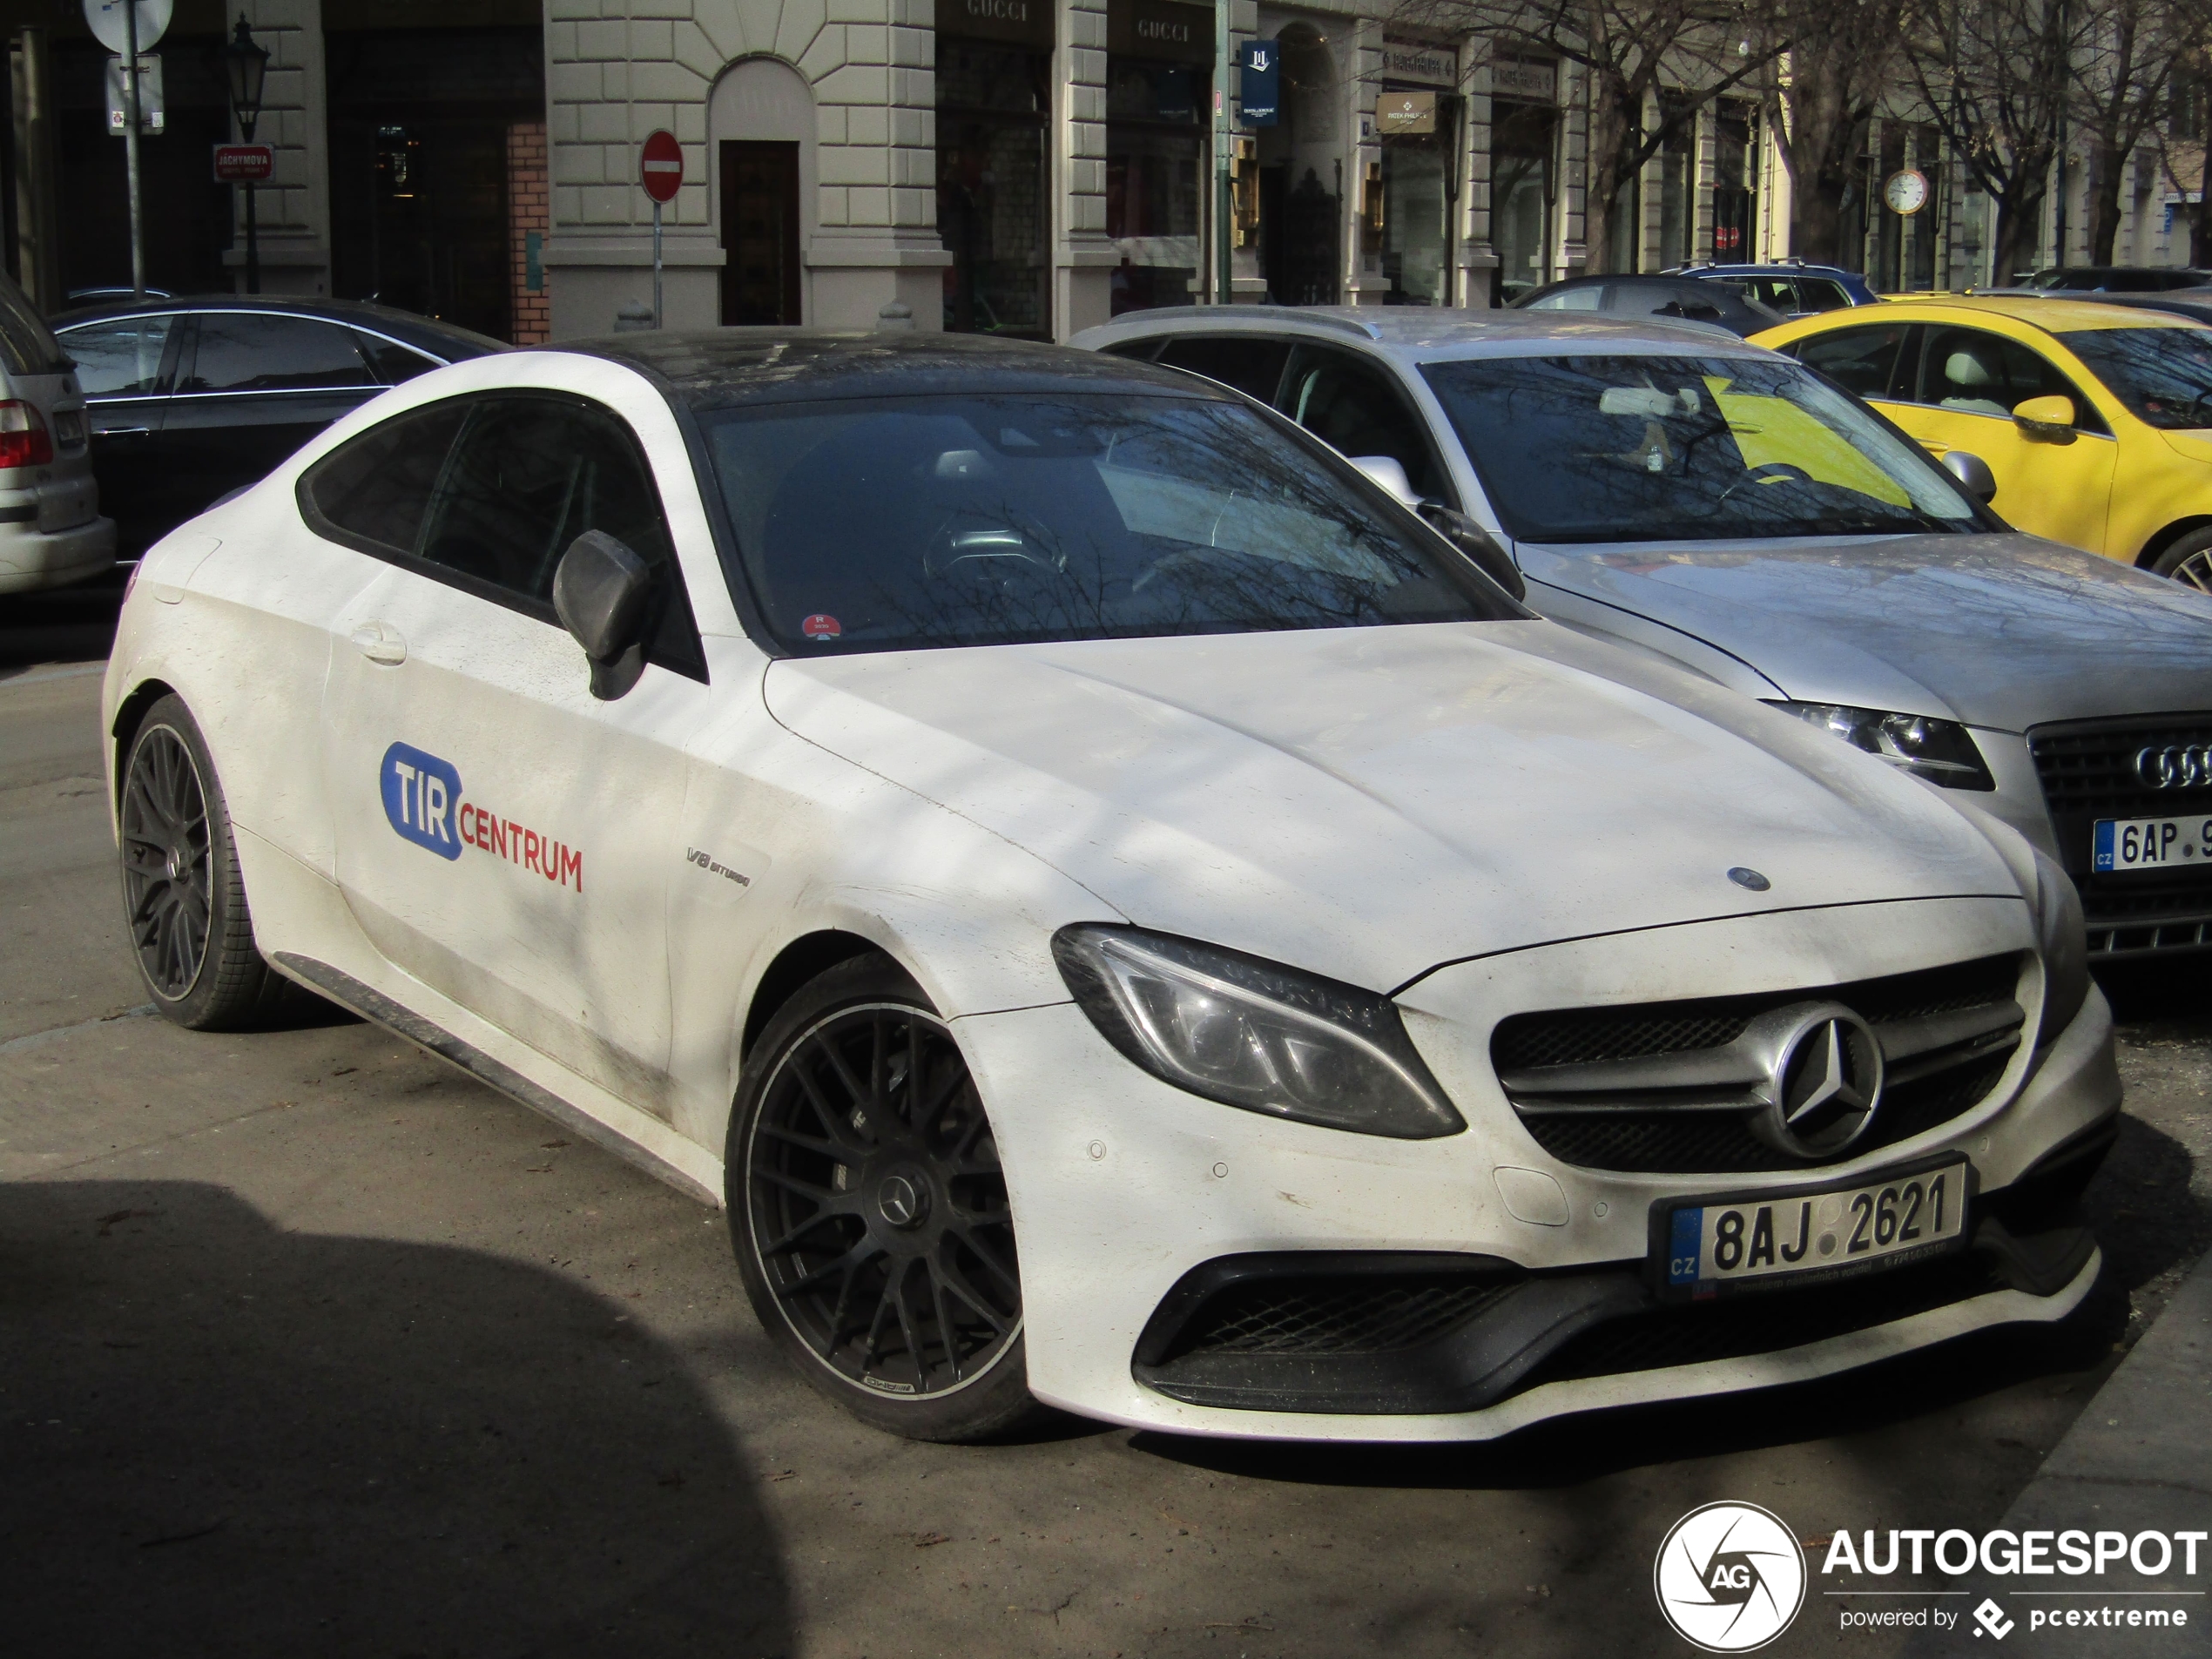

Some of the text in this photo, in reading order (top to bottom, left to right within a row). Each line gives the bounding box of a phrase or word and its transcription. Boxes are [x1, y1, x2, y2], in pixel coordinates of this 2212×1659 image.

[967, 0, 1027, 22] GUCCI
[1138, 18, 1189, 43] GUCCI
[395, 760, 450, 844] TIR
[460, 802, 583, 894] CENTRUM
[2097, 853, 2112, 865] CZ
[2121, 823, 2177, 863] 6AP
[687, 846, 751, 887] V8 BITURBO
[1714, 1173, 1946, 1271] 8AJ 2621
[1671, 1257, 1696, 1276] CZ
